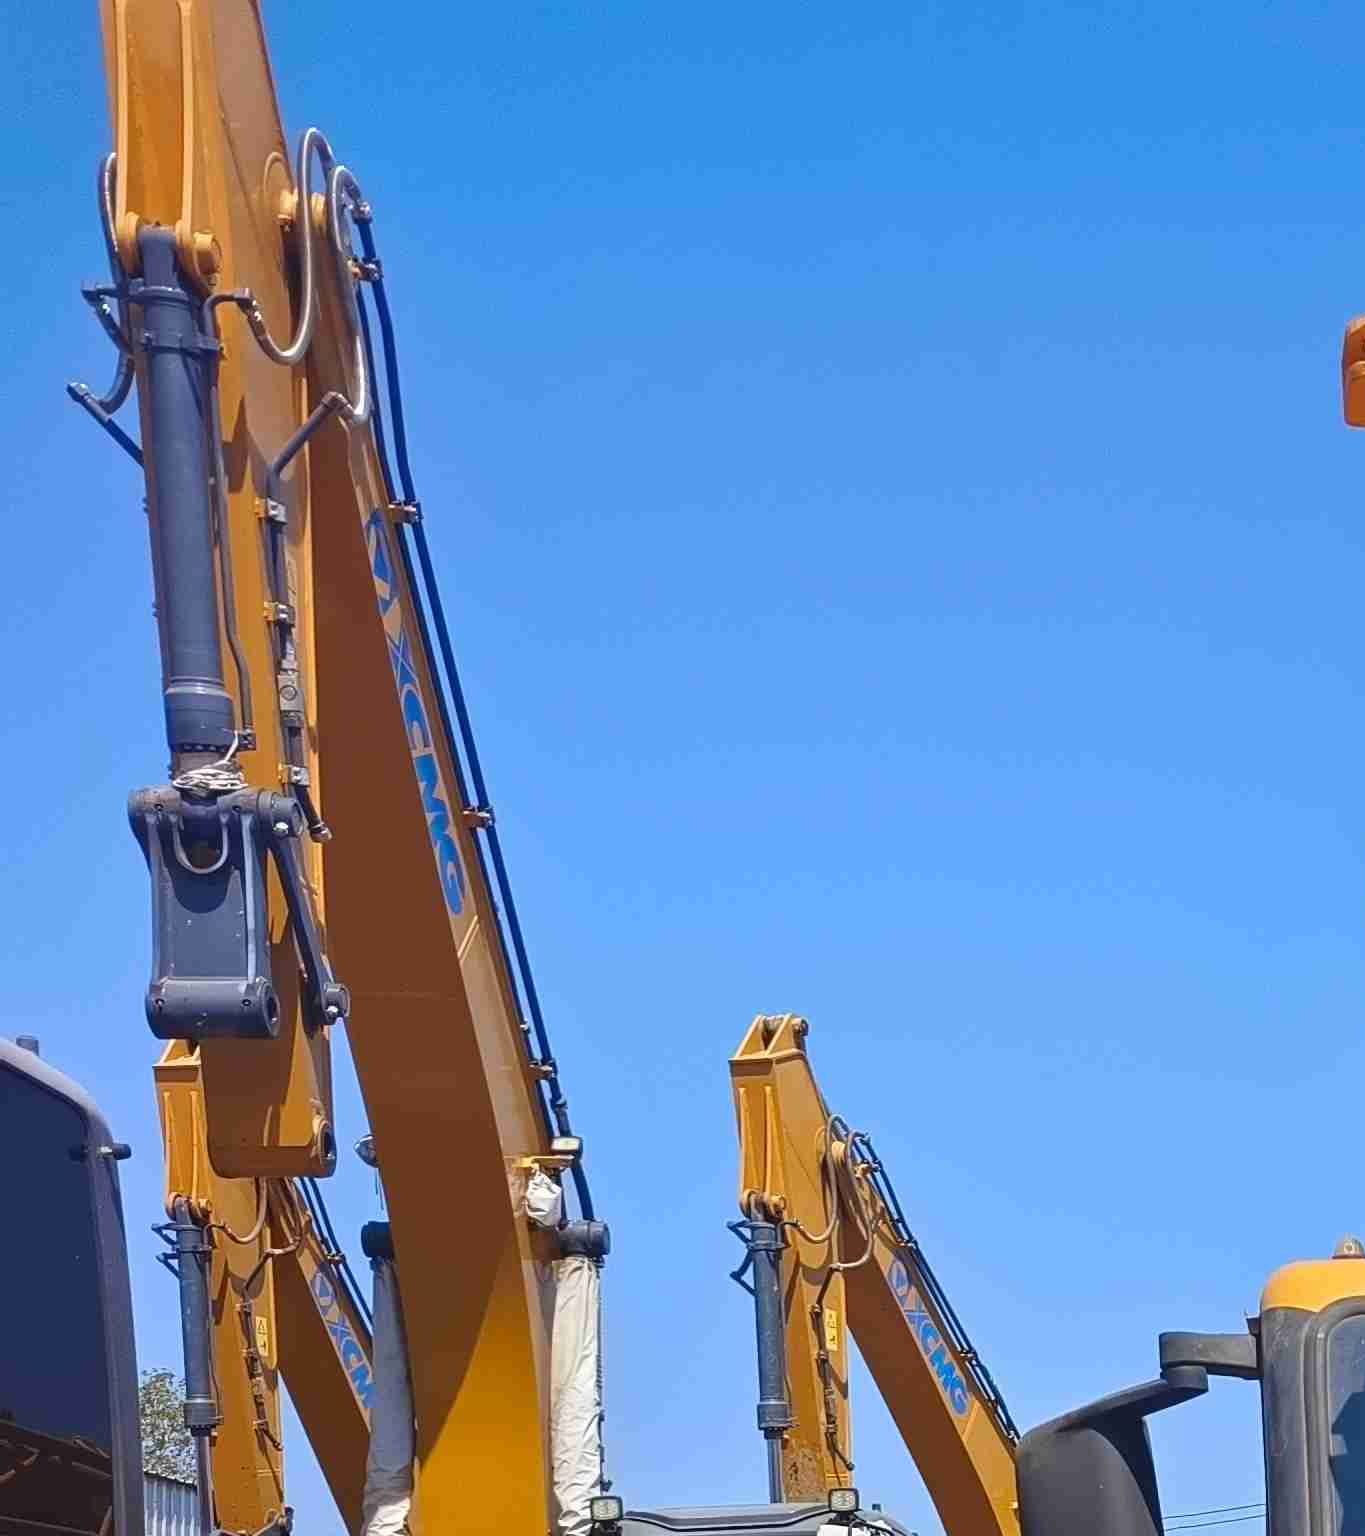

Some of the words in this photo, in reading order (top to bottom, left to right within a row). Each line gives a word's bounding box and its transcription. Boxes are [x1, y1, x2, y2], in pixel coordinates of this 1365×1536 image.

[385, 628, 465, 916] XCMG
[323, 1314, 380, 1410] XCM
[903, 1296, 970, 1418] XCMG
